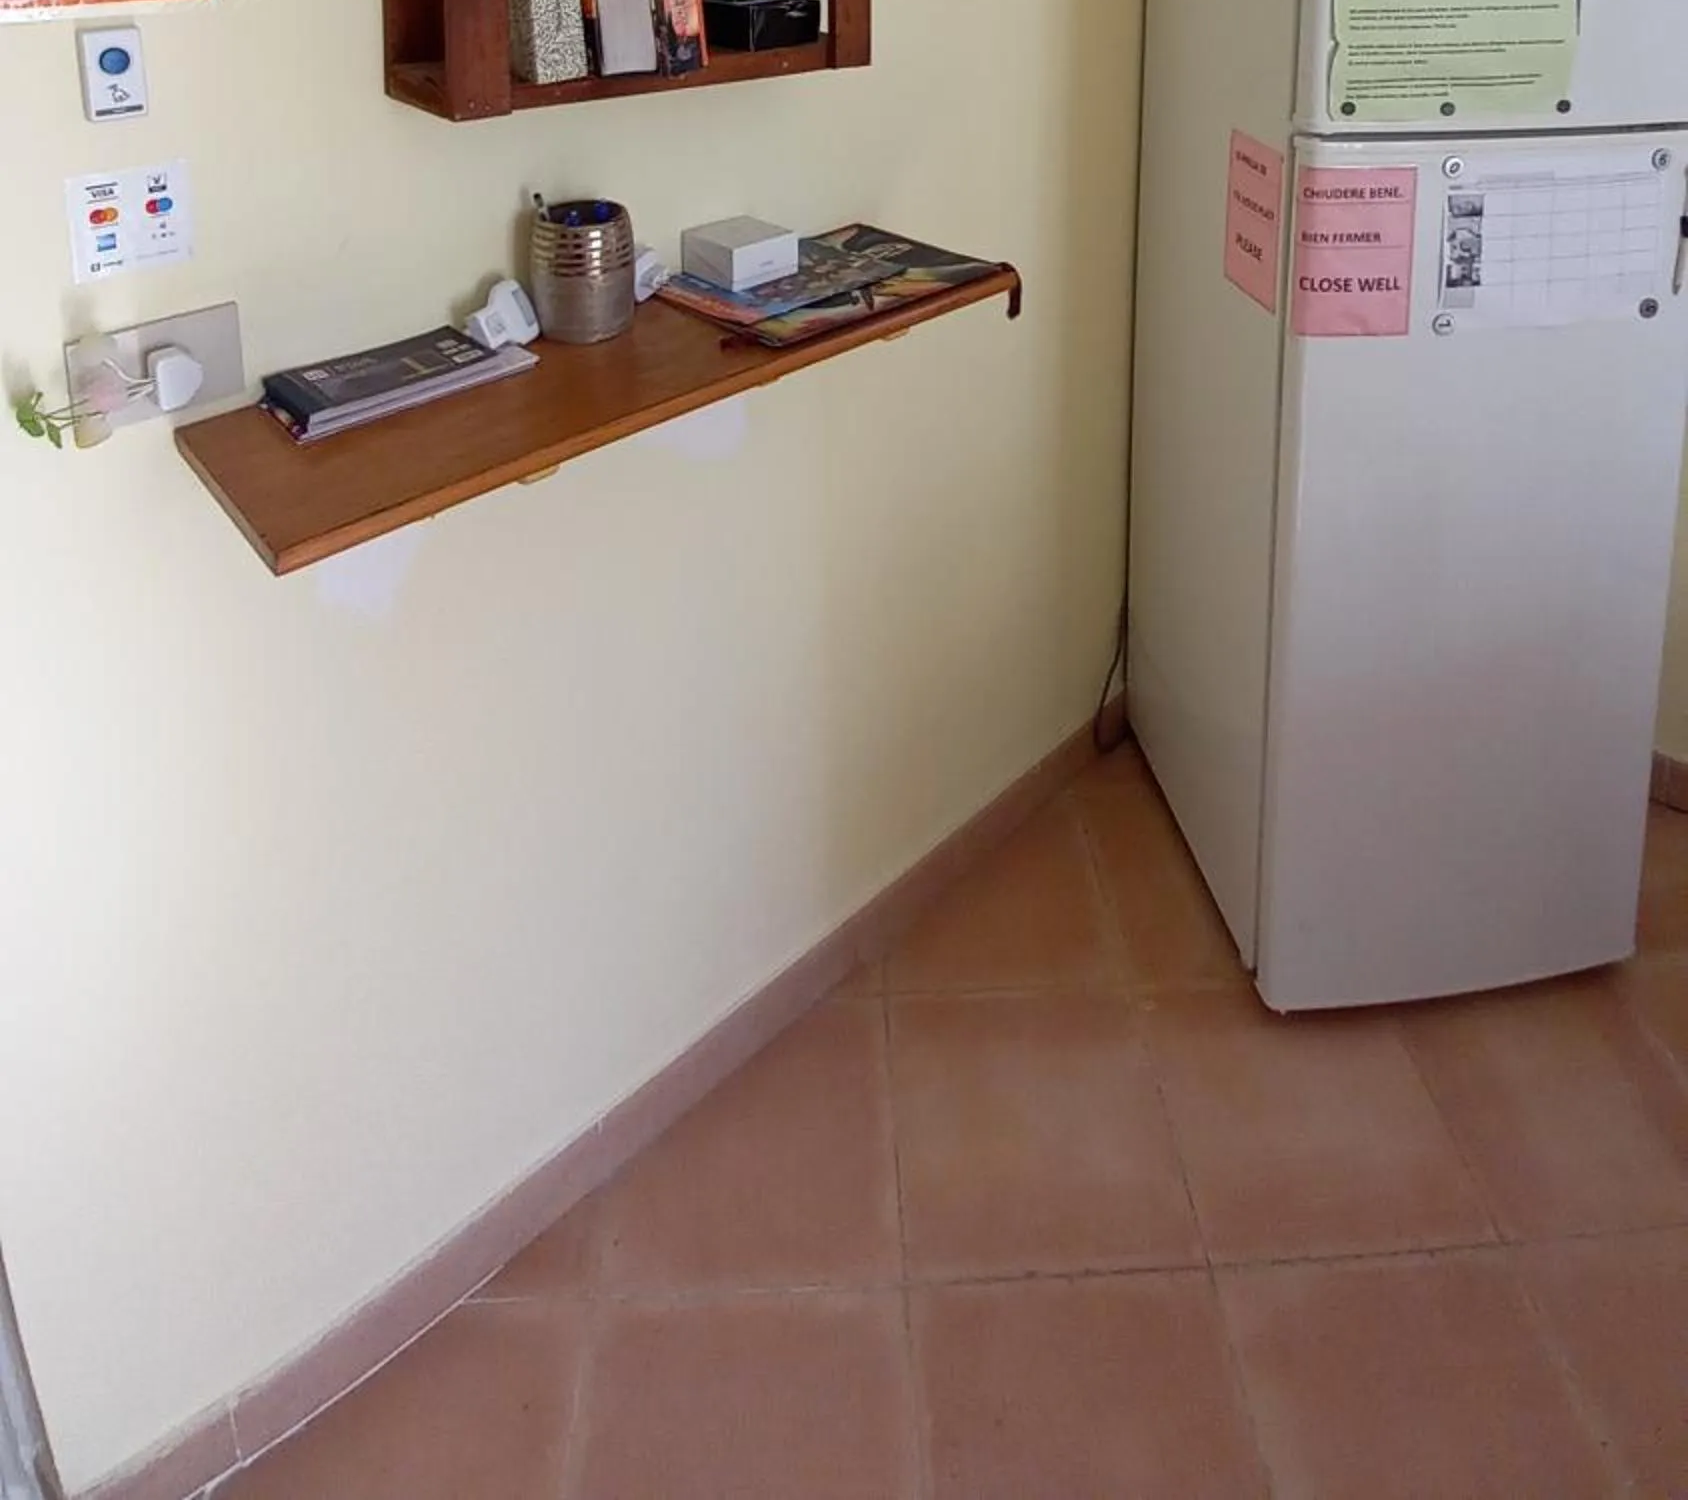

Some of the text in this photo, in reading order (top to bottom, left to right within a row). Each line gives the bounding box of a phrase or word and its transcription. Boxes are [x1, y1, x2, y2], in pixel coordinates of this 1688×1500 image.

[1303, 187, 1365, 199] CHIUDERE
[1301, 231, 1382, 243] BIEN FERMER
[1299, 276, 1402, 293] CLOSE WELL
